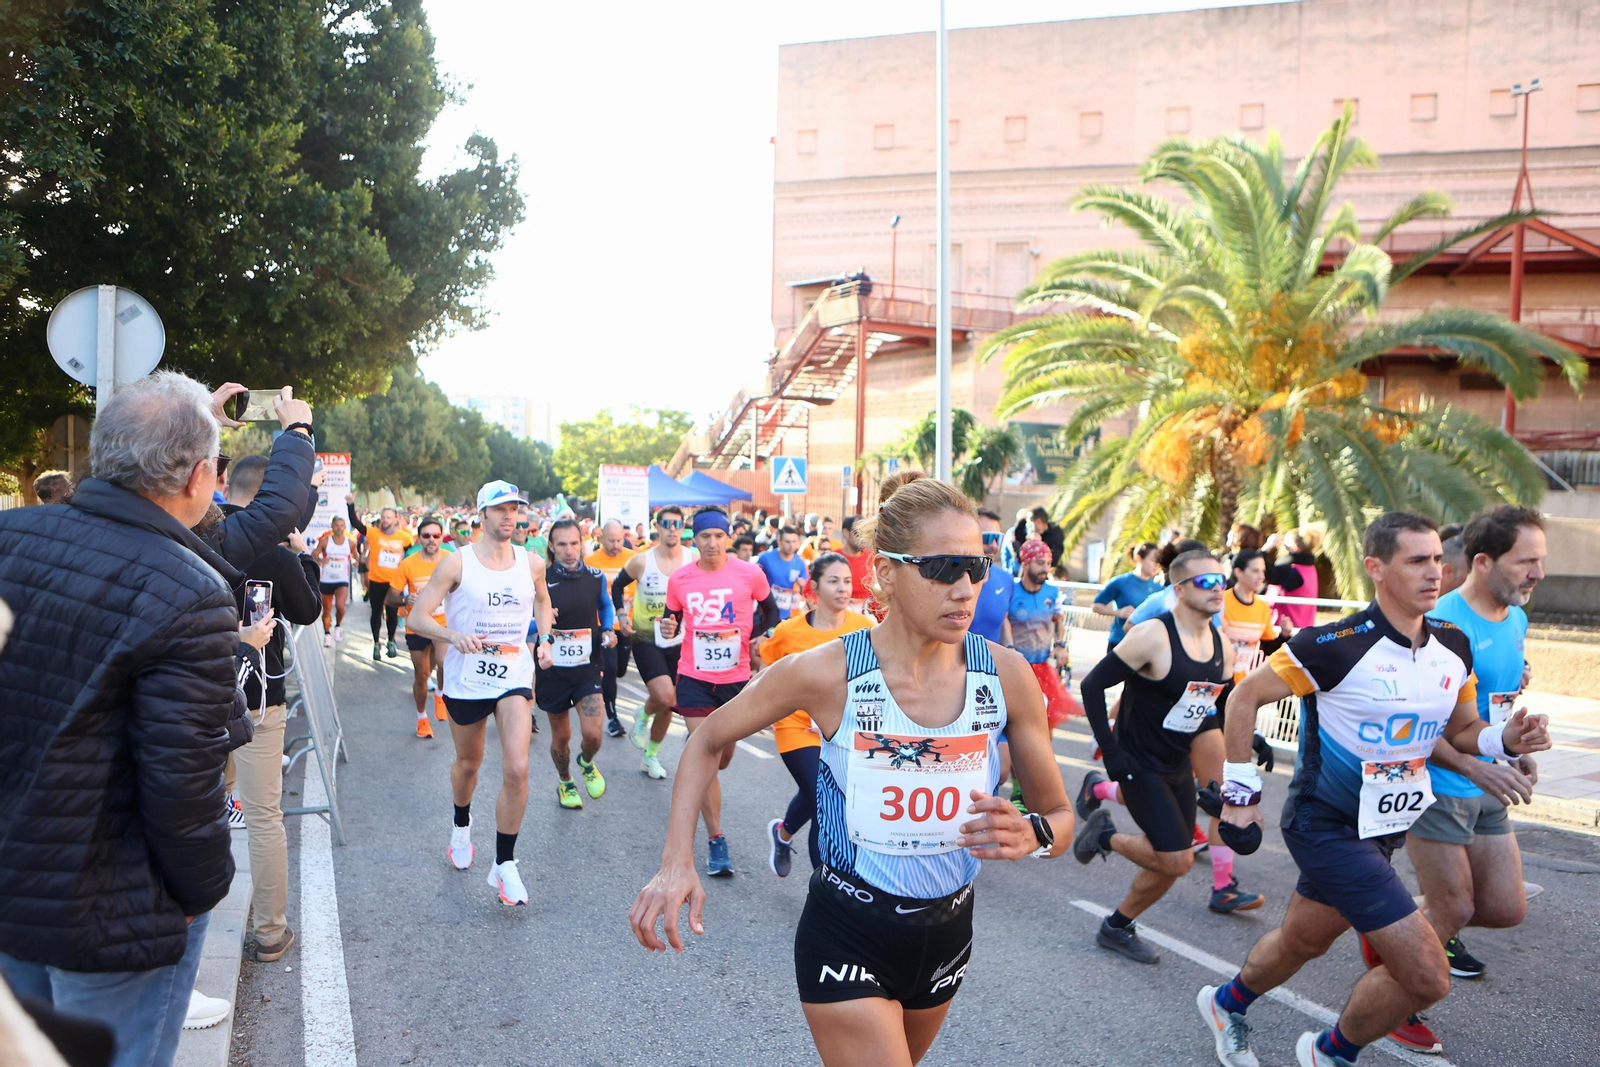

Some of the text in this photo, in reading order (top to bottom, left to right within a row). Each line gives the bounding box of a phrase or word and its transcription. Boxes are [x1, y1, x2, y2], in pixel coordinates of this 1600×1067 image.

[603, 465, 647, 476] SALIDA
[487, 592, 501, 606] 15
[646, 602, 664, 613] CAP
[559, 645, 583, 657] 563
[704, 647, 733, 660] 354
[475, 660, 508, 679] 382
[955, 749, 985, 761] XII
[1356, 744, 1374, 754] club
[1375, 747, 1387, 755] de
[1387, 745, 1421, 756] orientación
[879, 785, 960, 823] 300
[1378, 790, 1424, 814] 602
[827, 872, 874, 903] PRO
[951, 880, 974, 909] NIK
[818, 963, 880, 987] NIK
[930, 963, 967, 994] PR
